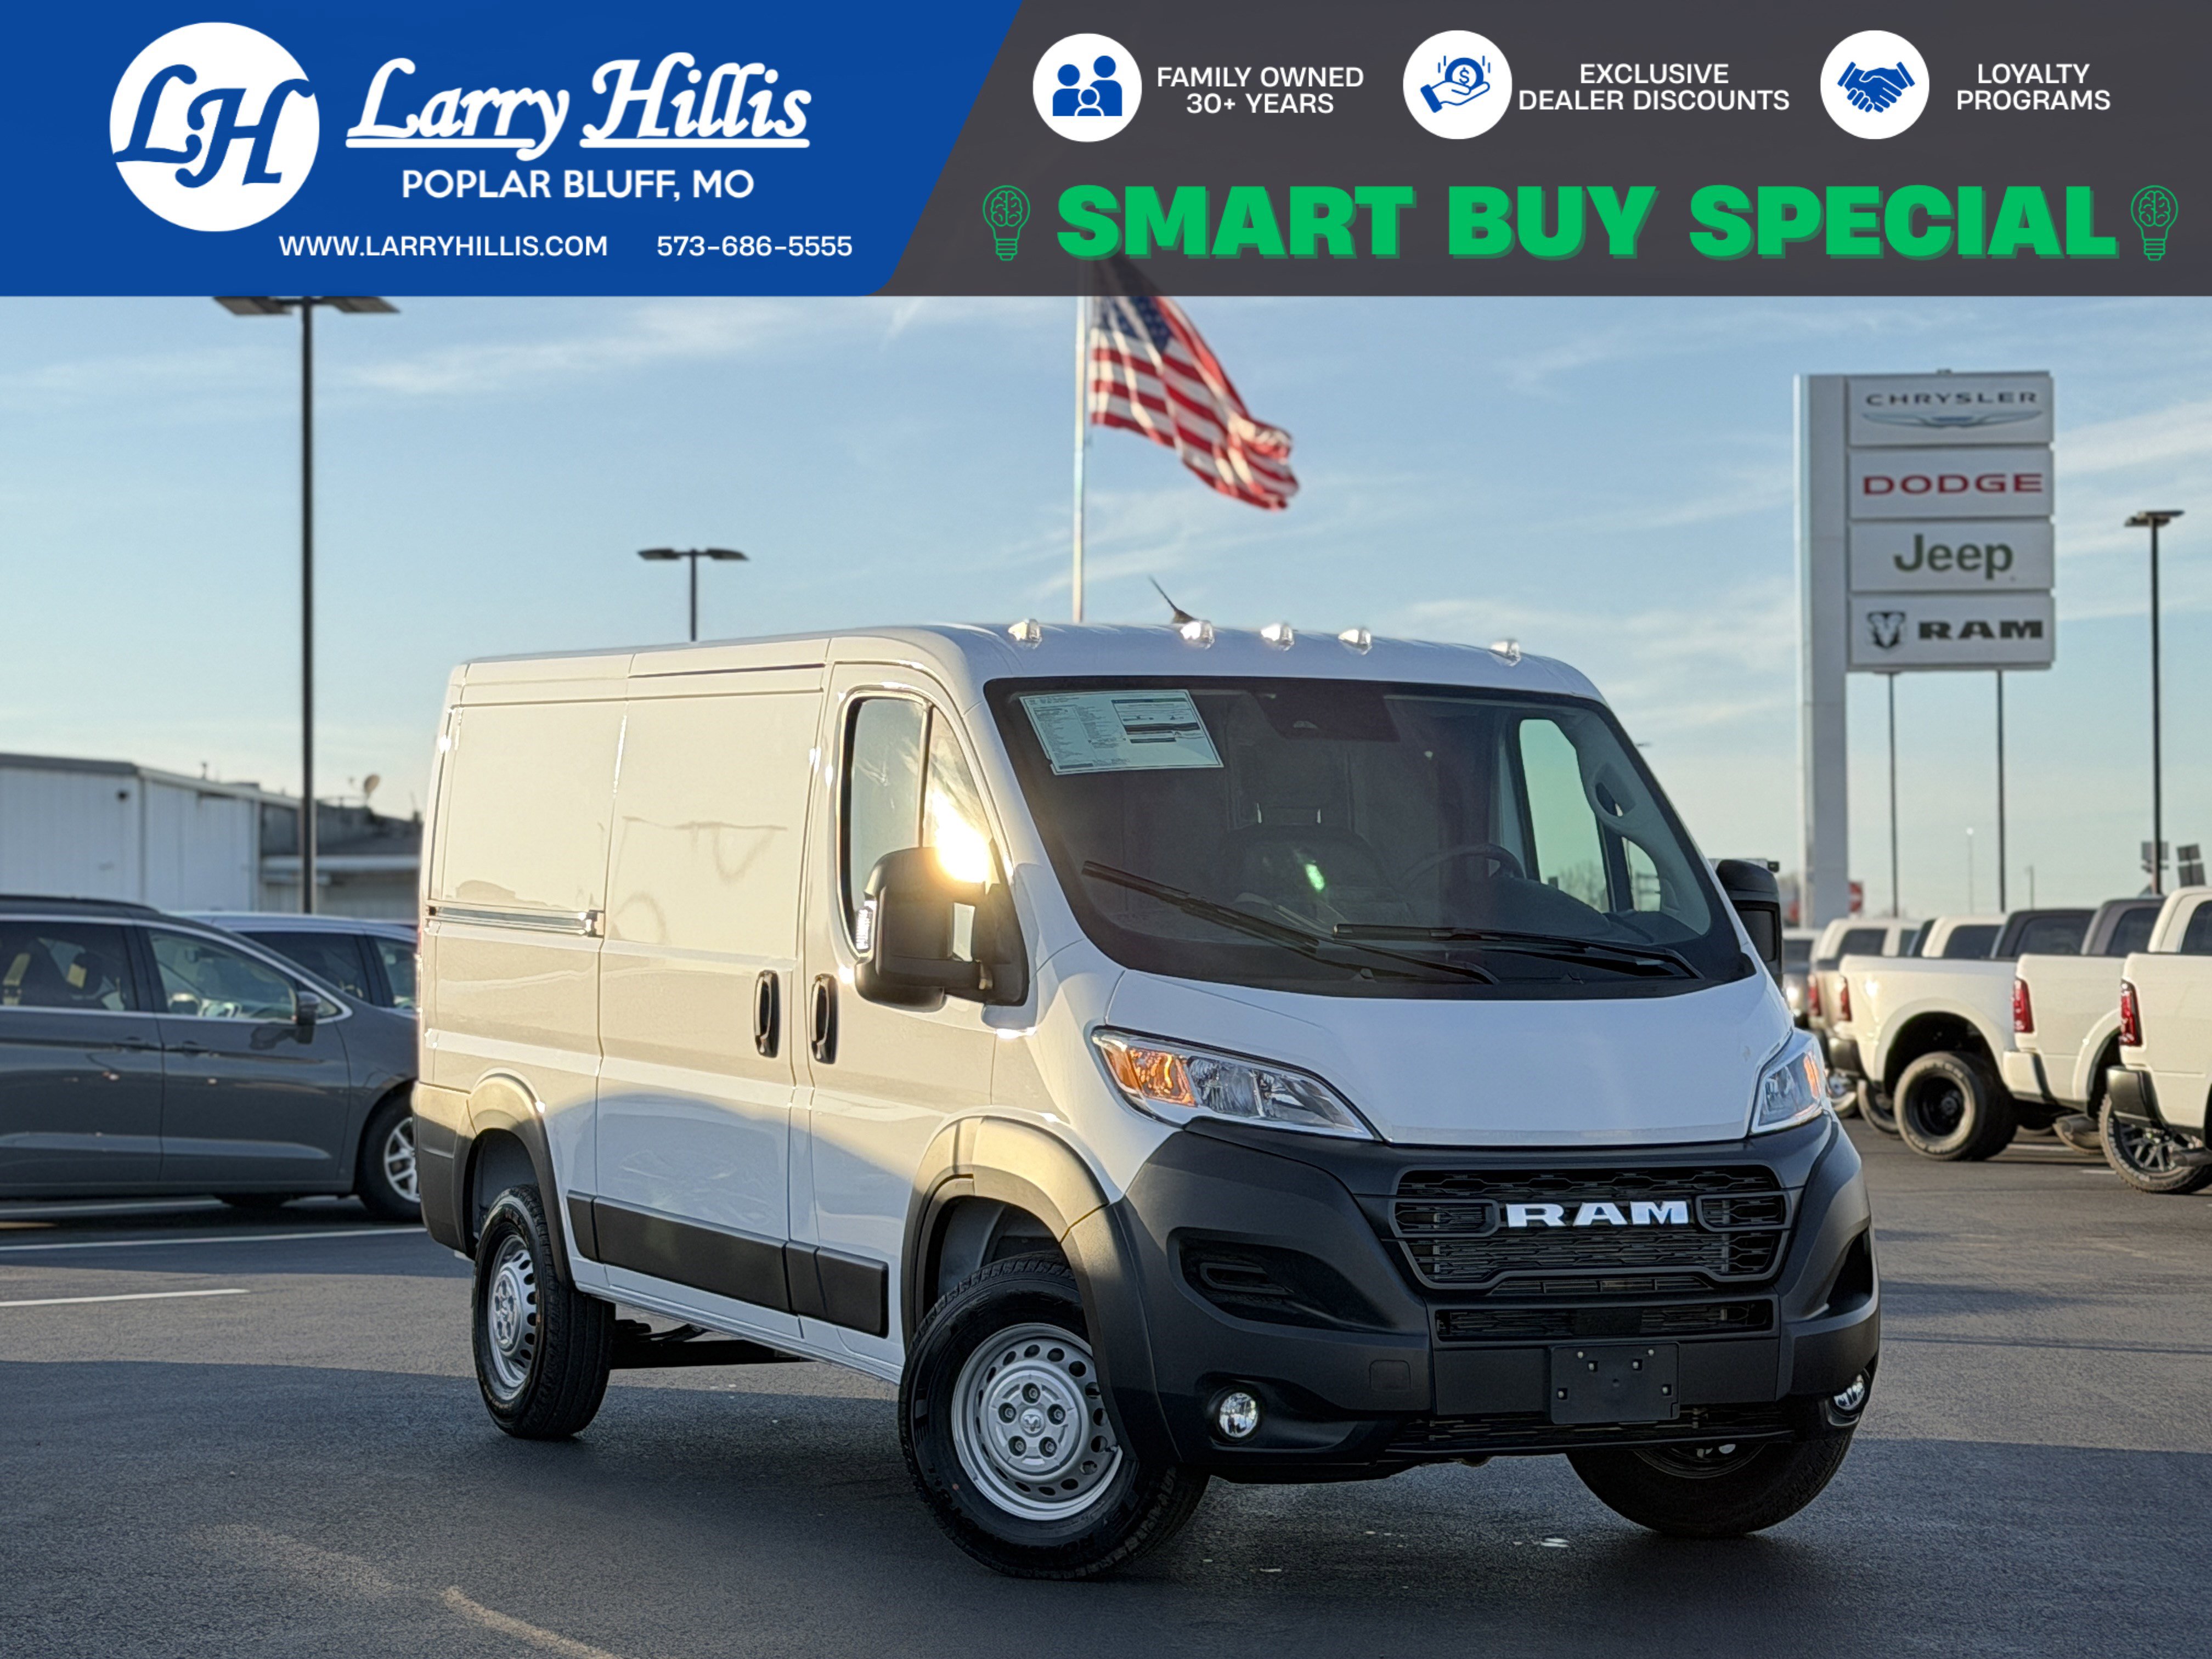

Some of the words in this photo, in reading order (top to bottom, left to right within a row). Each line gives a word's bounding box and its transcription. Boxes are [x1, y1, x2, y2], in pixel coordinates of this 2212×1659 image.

[1866, 392, 2038, 407] CHRYSLER
[1863, 473, 2043, 495] DODGE
[1893, 533, 2013, 580] Jeep
[1918, 620, 2044, 640] RAM
[1505, 1200, 1689, 1228] RAM
